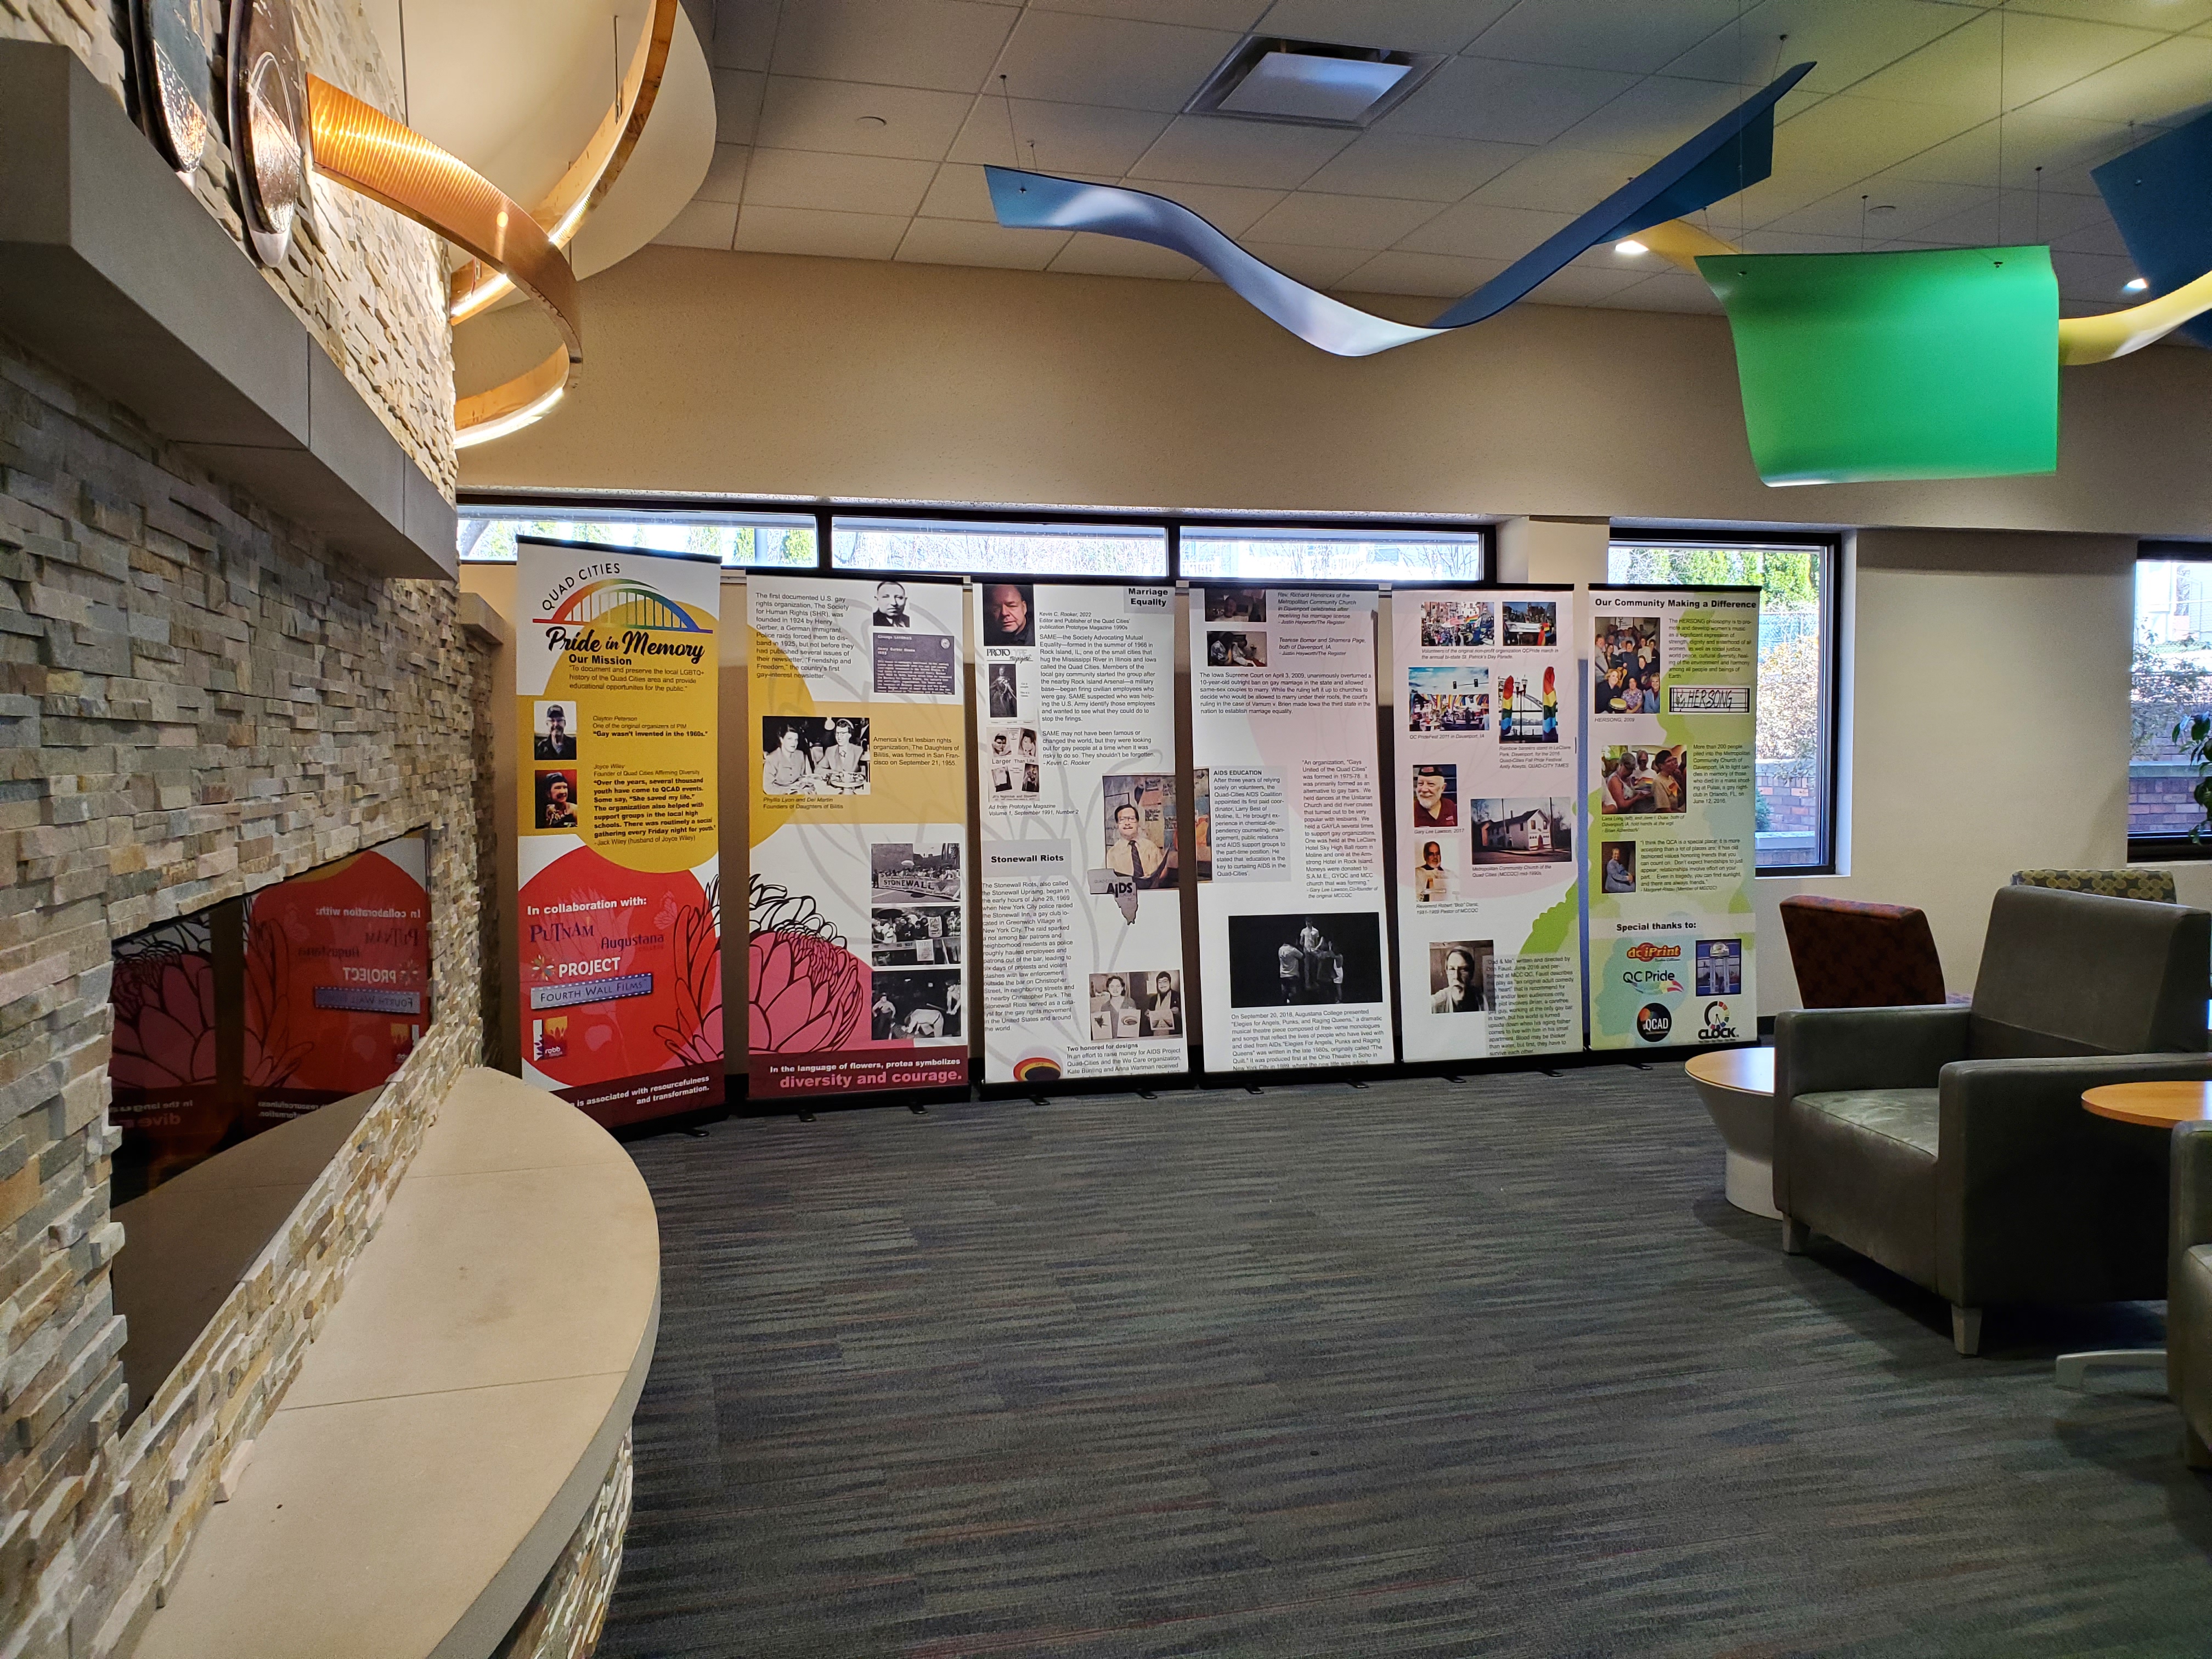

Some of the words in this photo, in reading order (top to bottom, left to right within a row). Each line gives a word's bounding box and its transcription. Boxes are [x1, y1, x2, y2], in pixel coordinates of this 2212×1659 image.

[542, 577, 574, 611] QUAD
[579, 563, 620, 580] CITIES
[1128, 588, 1168, 597] Marriage
[1130, 599, 1166, 607] Equality
[1615, 599, 1664, 608] Community
[1668, 600, 1700, 609] Making
[546, 626, 601, 652] Pride
[606, 636, 619, 650] in
[622, 631, 704, 664] Memory
[569, 654, 589, 664] Our
[591, 655, 632, 665] Mission
[1687, 690, 1732, 712] HERSONG
[991, 855, 1037, 864] Stonewall
[884, 879, 934, 890] STONEWALL
[528, 906, 539, 915] In
[544, 900, 617, 914] collaboration
[620, 896, 646, 907] with:
[1616, 923, 1649, 932] Special
[601, 934, 664, 952] Augustana
[1628, 949, 1643, 957] dc
[1645, 946, 1680, 957] iPrint
[559, 957, 621, 978] PROJECT
[1623, 971, 1643, 983] QC
[1646, 970, 1675, 981] Pride
[540, 990, 580, 1003] FOURTH
[585, 986, 612, 996] WALL
[617, 982, 642, 991] FILMS
[1240, 1012, 1268, 1020] September
[1344, 1008, 1369, 1017] presented
[1646, 1018, 1668, 1031] QCAD
[1698, 1027, 1736, 1039] CLOCK
[885, 1060, 913, 1069] protea
[915, 1058, 960, 1068] symbolizes
[780, 1073, 851, 1087] diversity
[857, 1071, 887, 1084] and
[891, 1071, 962, 1083] courage.
[586, 1091, 629, 1105] associated
[631, 1087, 648, 1097] with
[650, 1076, 709, 1093] resourcefulness
[636, 1096, 651, 1105] and
[653, 1086, 709, 1102] transformation.
